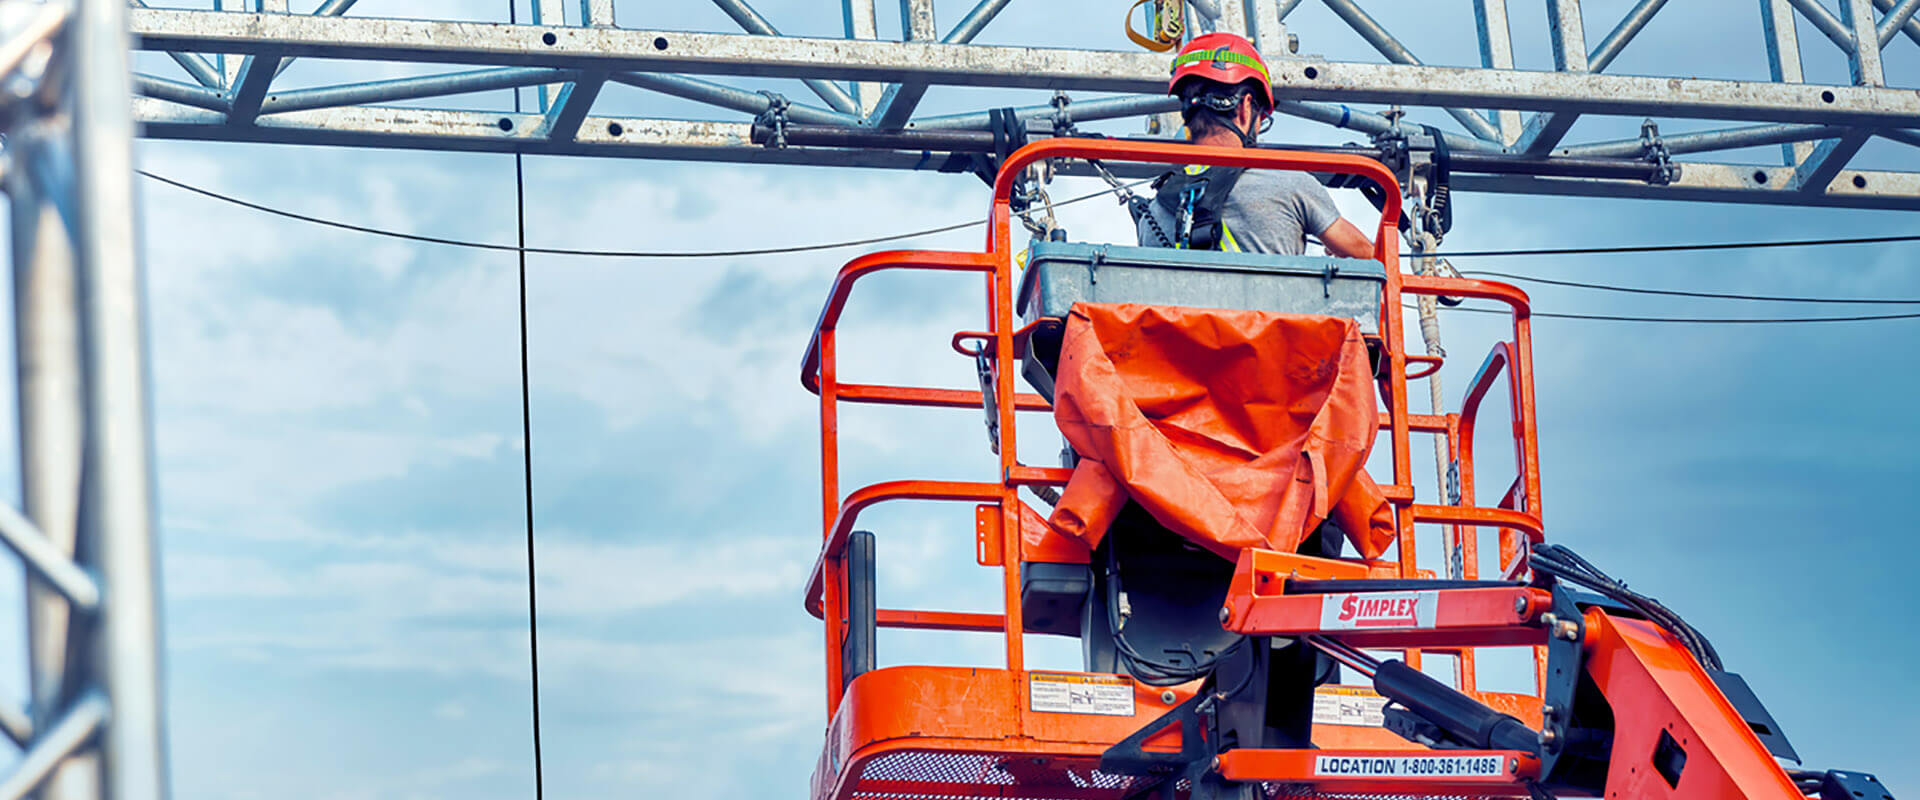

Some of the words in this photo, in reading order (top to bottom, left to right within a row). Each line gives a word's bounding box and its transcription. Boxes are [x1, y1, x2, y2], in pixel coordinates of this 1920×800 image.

[1338, 595, 1418, 626] SIMPLEX
[1321, 758, 1396, 774] LOCATION
[1402, 758, 1497, 774] 1-800-361-1486
